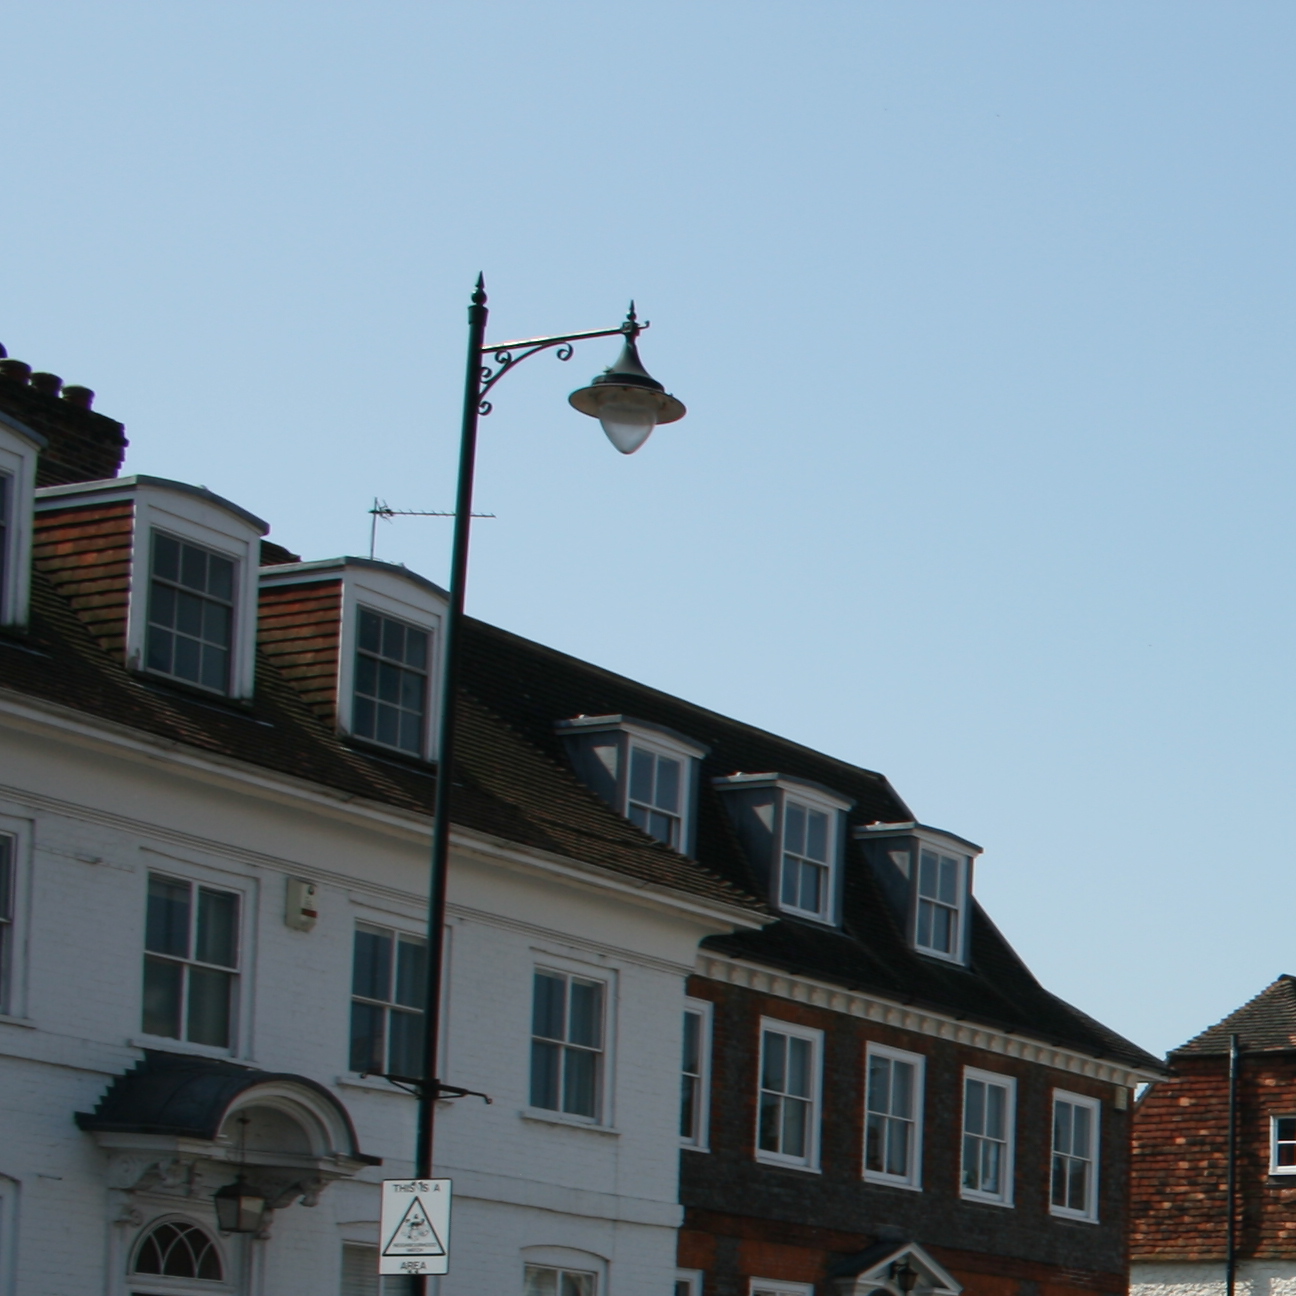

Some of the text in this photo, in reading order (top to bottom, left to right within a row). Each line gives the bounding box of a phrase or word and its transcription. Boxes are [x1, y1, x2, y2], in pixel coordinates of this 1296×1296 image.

[393, 1184, 441, 1192] THIS IS A
[400, 1261, 427, 1270] AREA
